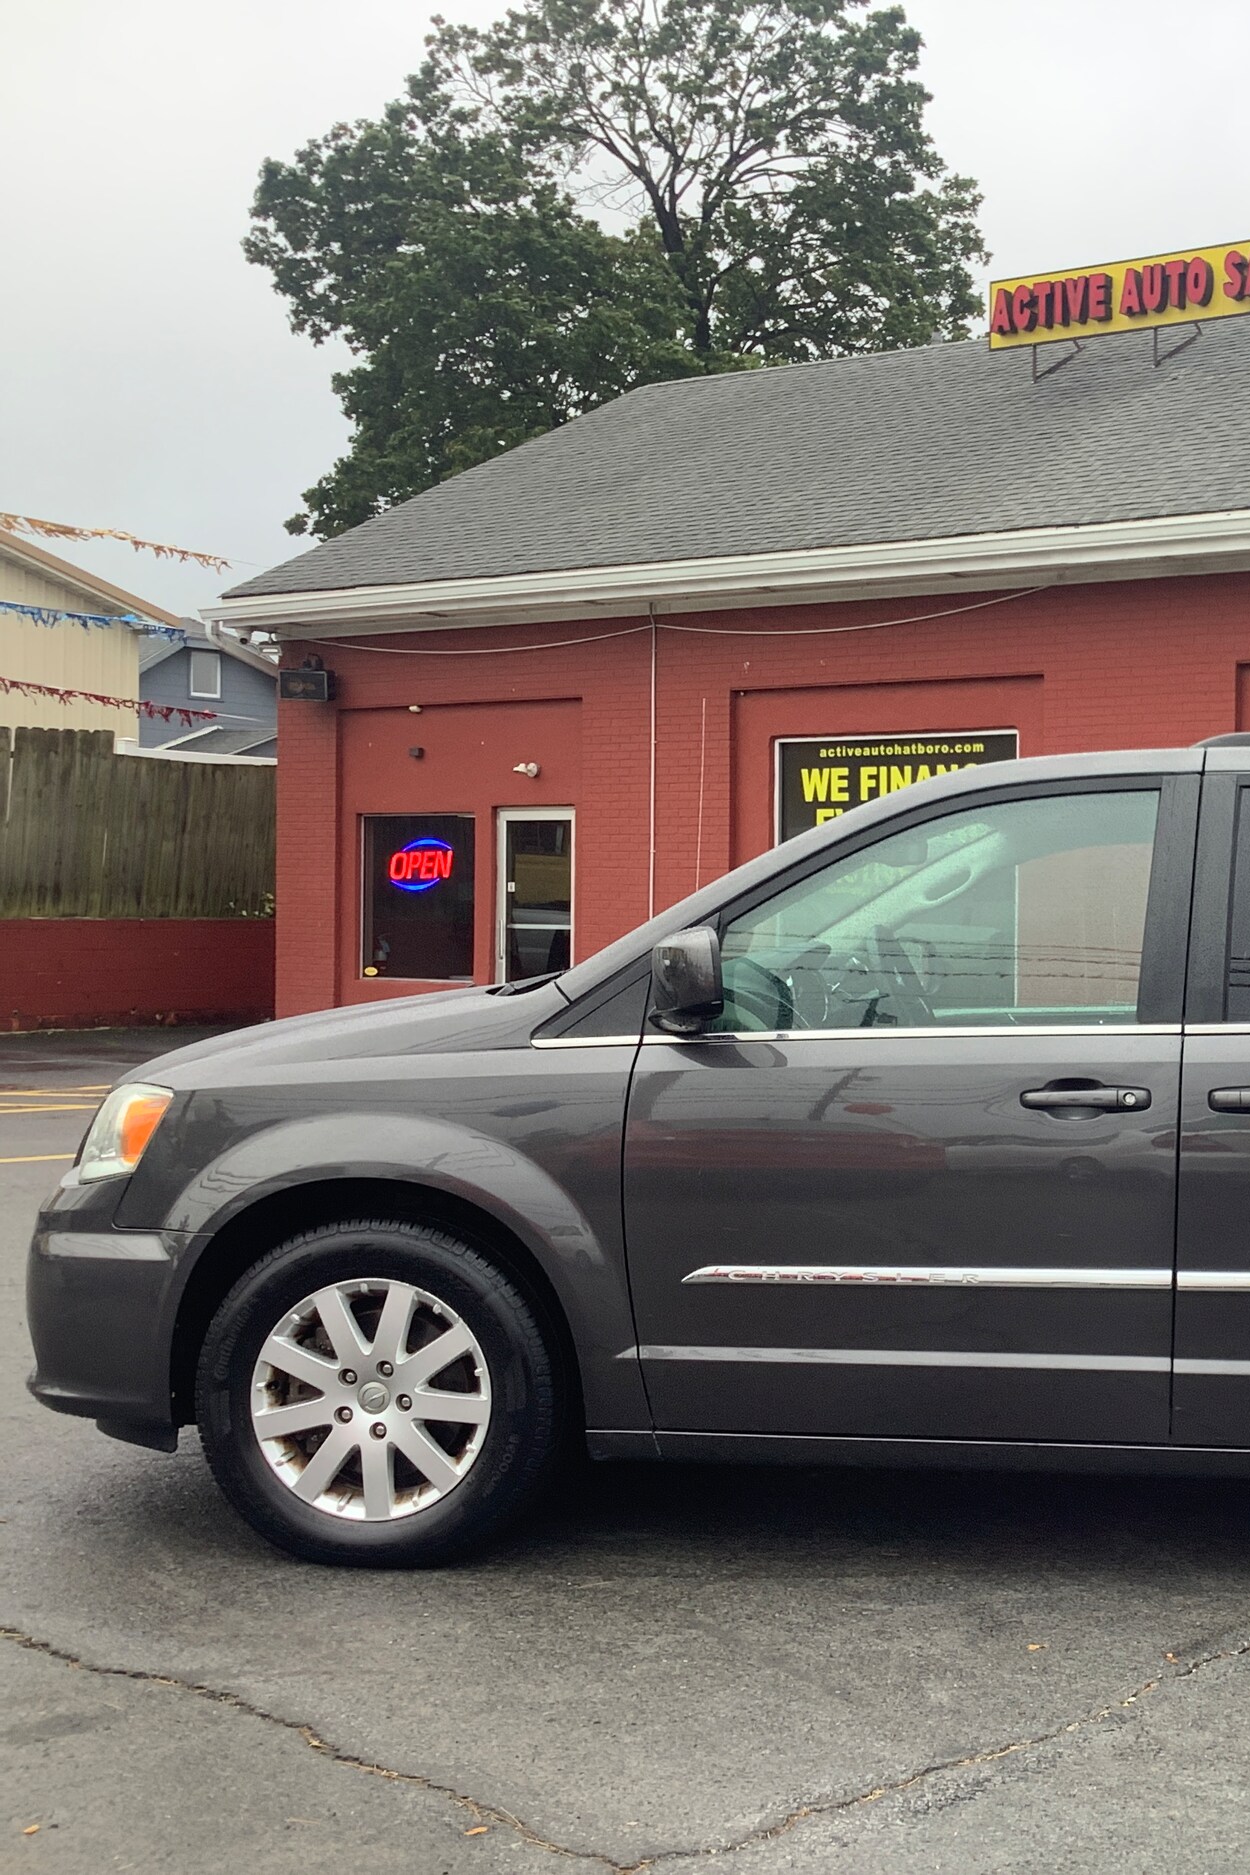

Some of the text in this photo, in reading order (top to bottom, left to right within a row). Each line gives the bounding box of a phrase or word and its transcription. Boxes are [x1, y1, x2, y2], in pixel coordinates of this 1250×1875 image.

[991, 273, 1112, 336] ACTIVE
[1119, 257, 1213, 316] AUTO
[819, 742, 985, 758] activeautohatboro.com
[801, 767, 849, 802] WE
[390, 850, 453, 880] OPEN
[727, 1270, 980, 1284] CHRYSLER
